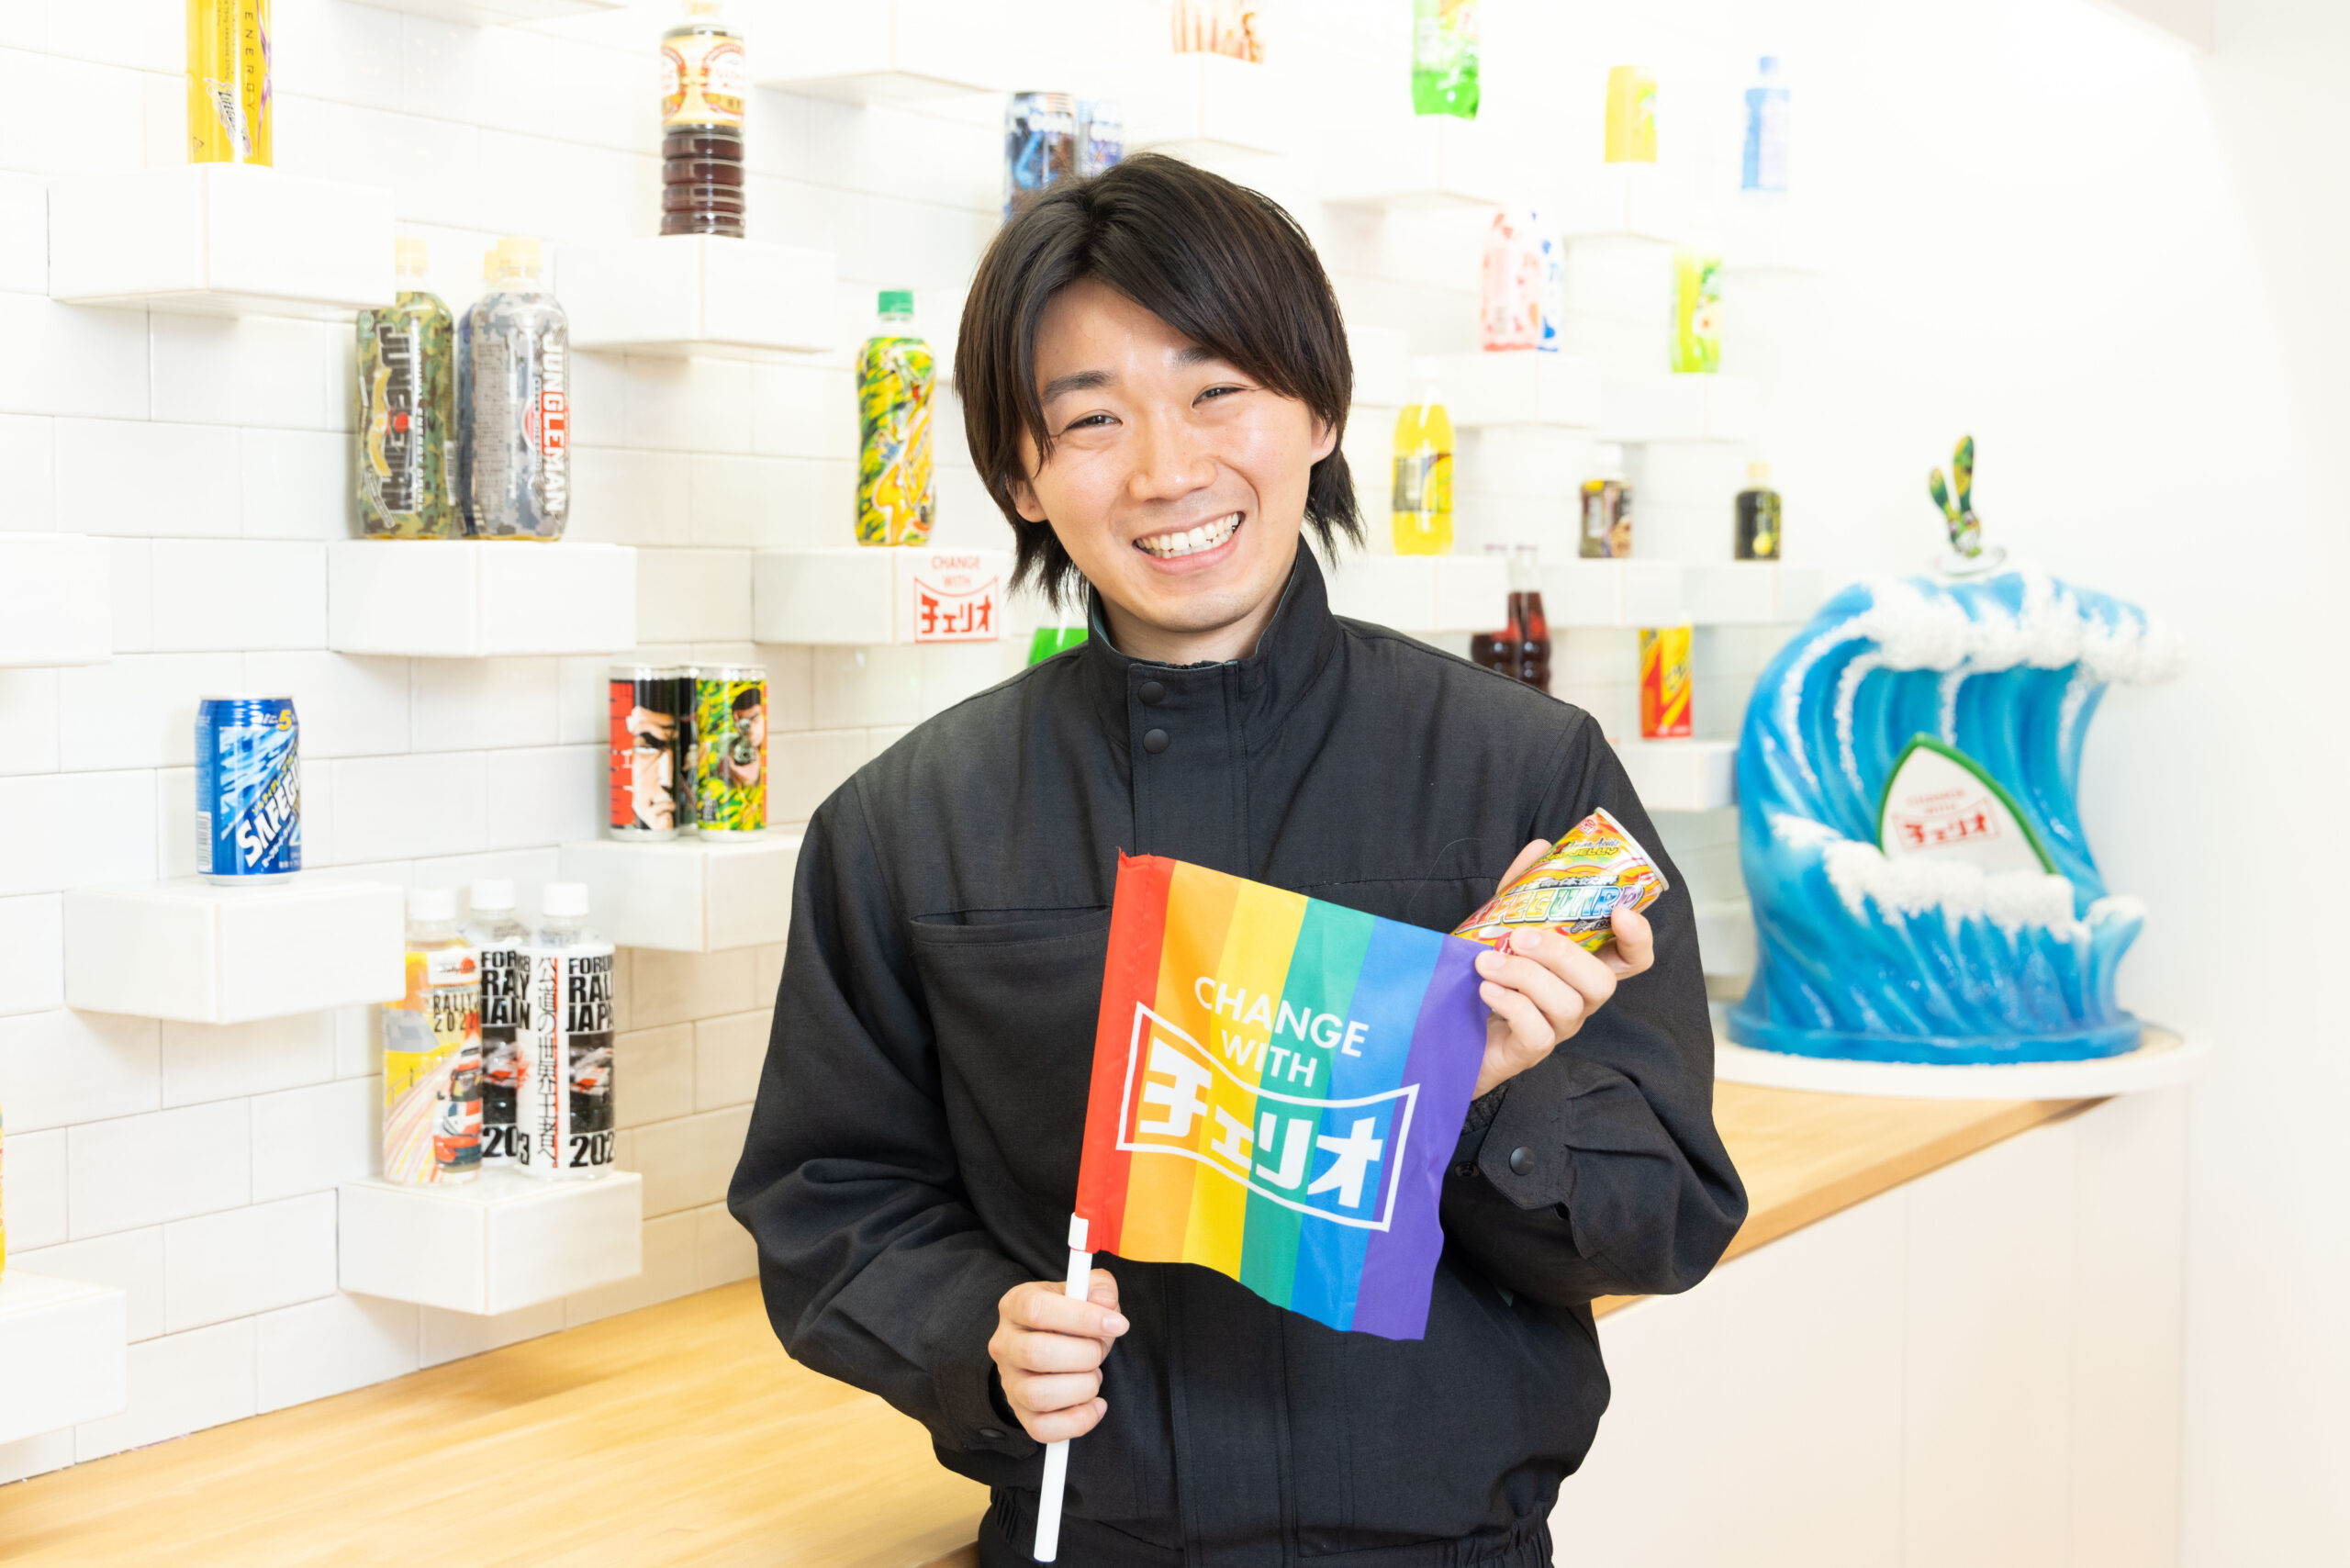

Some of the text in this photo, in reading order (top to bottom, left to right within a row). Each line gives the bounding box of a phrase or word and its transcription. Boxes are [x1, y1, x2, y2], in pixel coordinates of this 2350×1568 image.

[244, 12, 255, 111] ENERGY
[376, 323, 415, 514] JUNGEMAN
[542, 332, 566, 515] JUNGLEMAN
[931, 555, 980, 571] CHANGE
[921, 593, 991, 634] チェリオ
[1194, 976, 1370, 1058] CHANGE
[1220, 1029, 1317, 1088] WITH
[569, 1130, 615, 1169] 202
[1139, 1036, 1383, 1208] チェリオ
